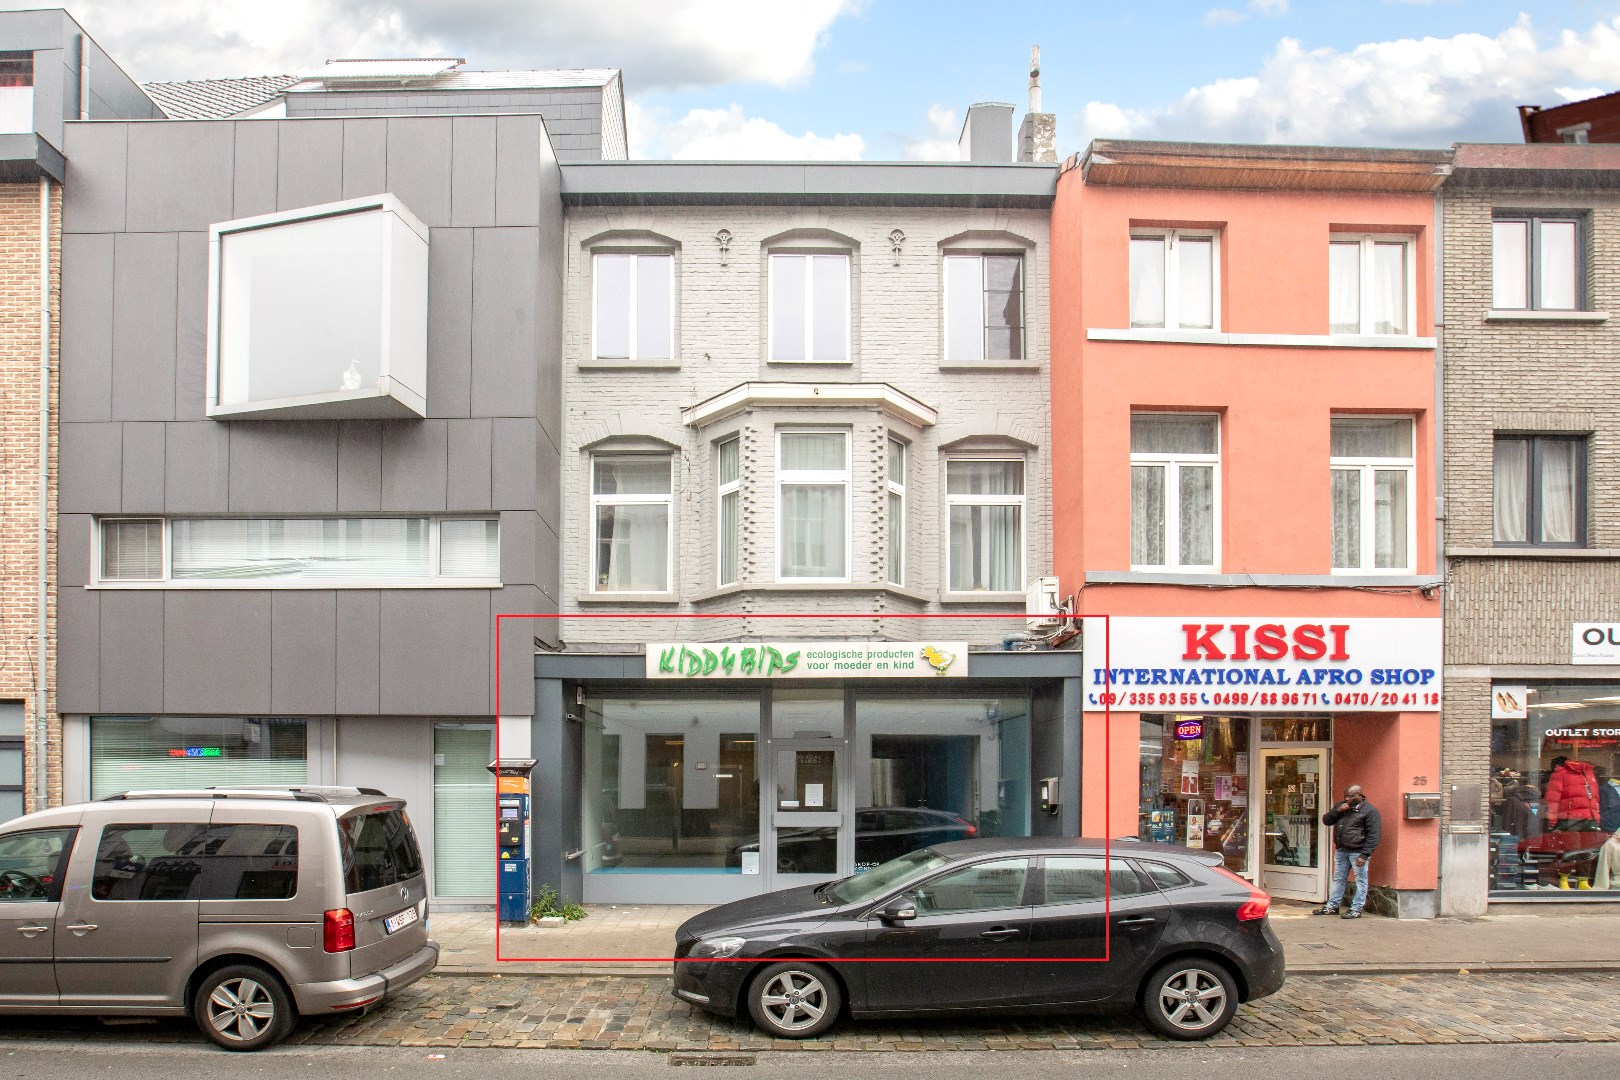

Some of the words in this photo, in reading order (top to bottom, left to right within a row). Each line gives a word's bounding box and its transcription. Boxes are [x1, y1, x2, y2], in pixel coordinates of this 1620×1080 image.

[1182, 623, 1350, 661] KISSI
[806, 650, 863, 660] ecologische
[867, 650, 915, 660] producten
[806, 662, 830, 670] voor
[833, 661, 872, 670] moeder
[876, 662, 888, 670] en
[893, 660, 915, 670] kind
[1093, 668, 1291, 686] INTERNATIONAL
[1296, 668, 1364, 686] AFRO
[1370, 668, 1435, 686] SHOP
[1178, 725, 1202, 735] OPEN
[1545, 728, 1590, 737] OUTLET
[1412, 776, 1428, 786] 25
